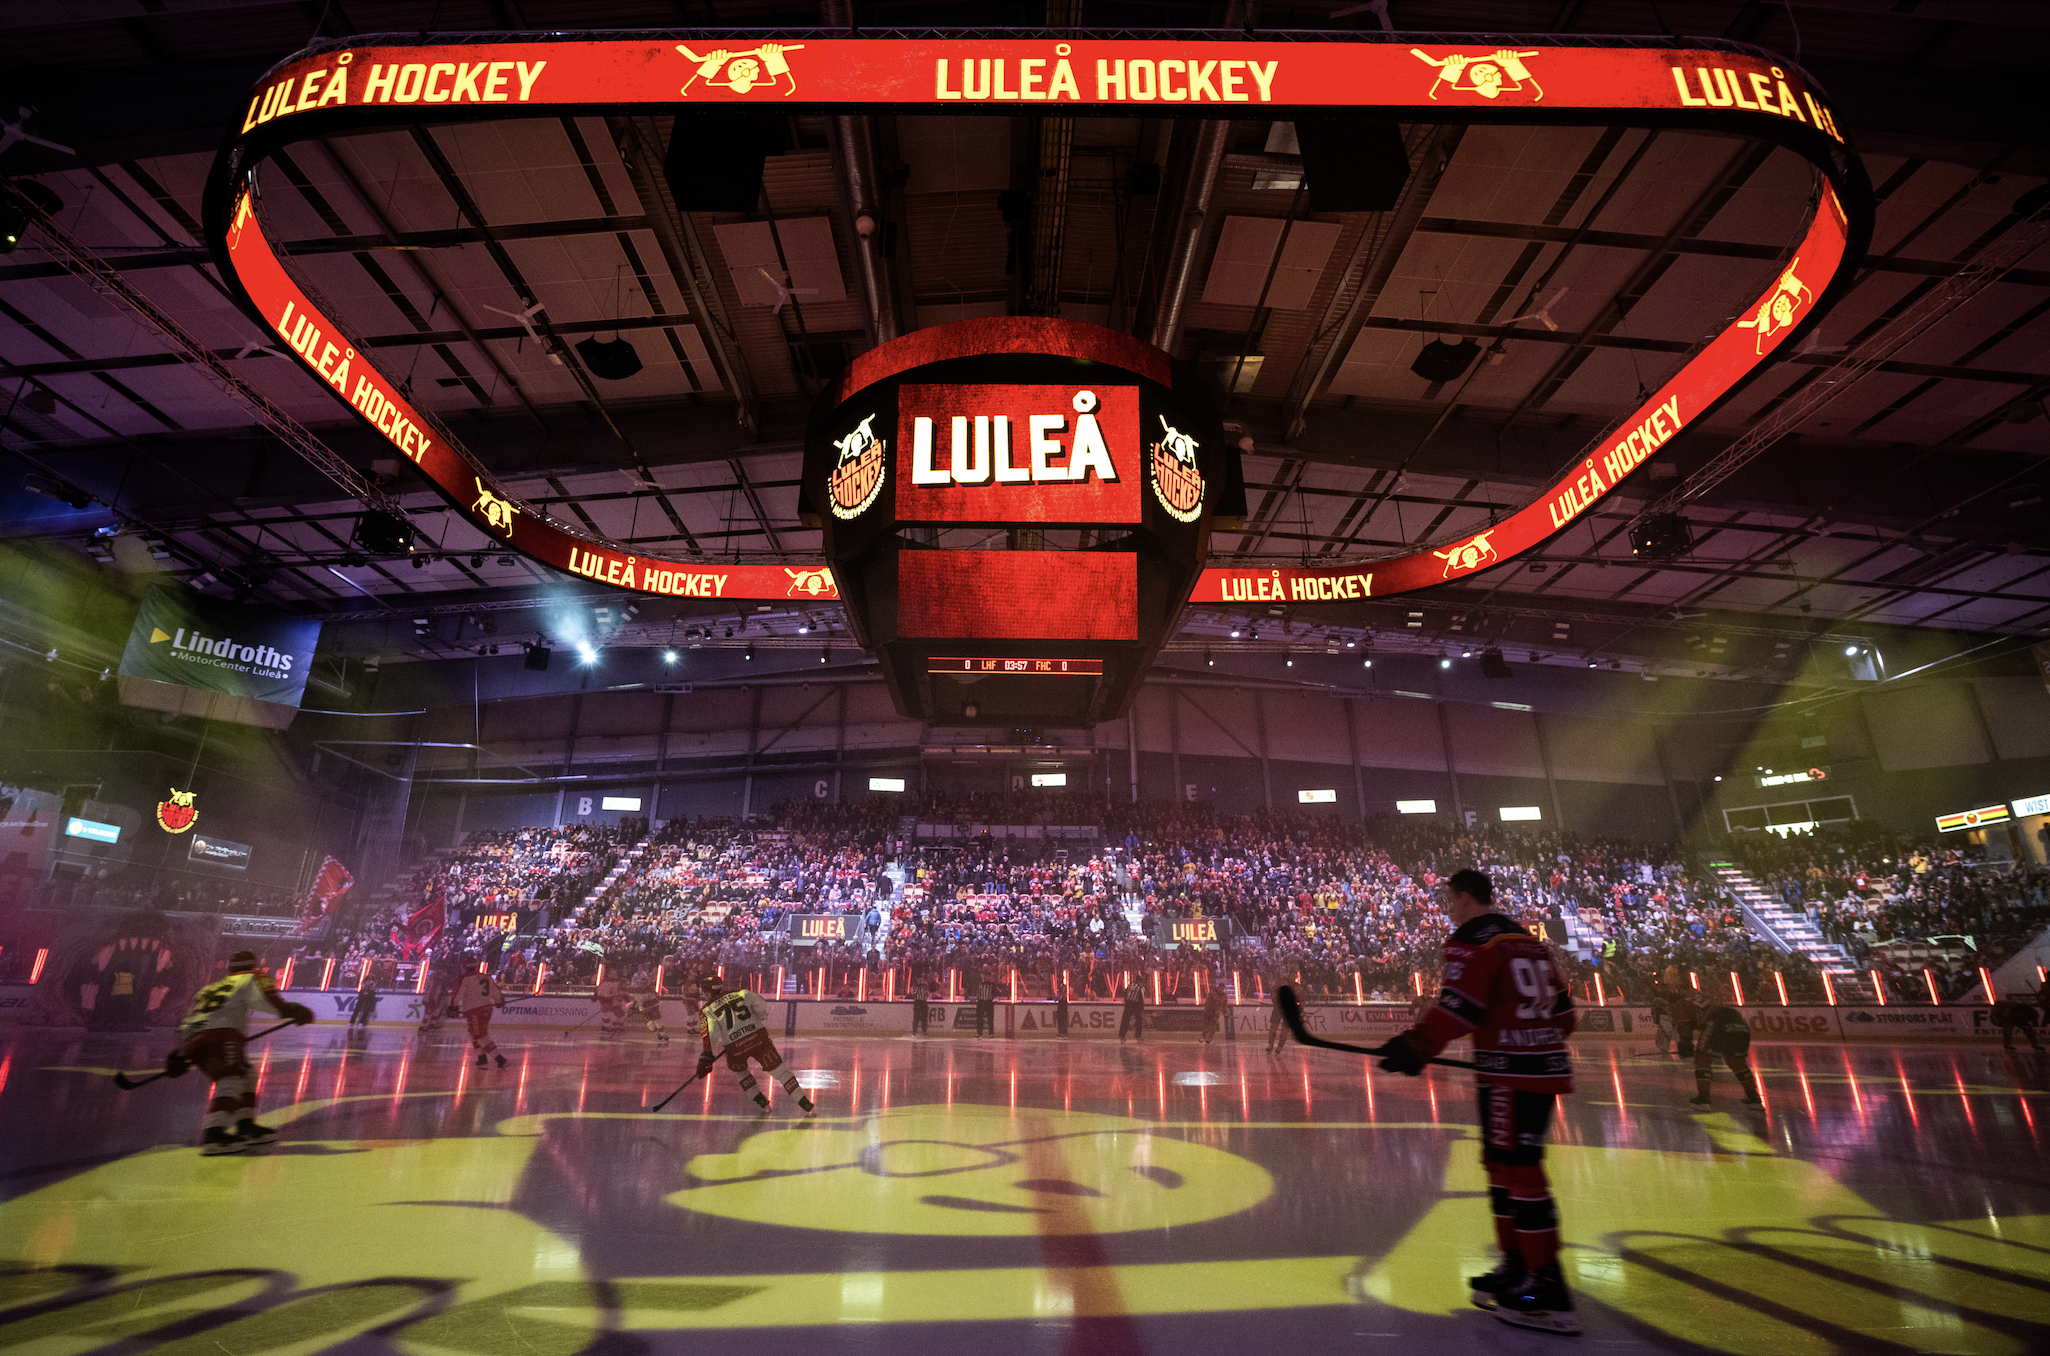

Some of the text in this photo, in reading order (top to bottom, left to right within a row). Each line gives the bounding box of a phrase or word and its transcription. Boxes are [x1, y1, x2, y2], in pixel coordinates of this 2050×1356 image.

[936, 43, 1278, 102] LULEÅ HOCKEY
[241, 52, 547, 134] LULEÅ HOCKEY
[1671, 66, 1807, 122] LULEÅ
[277, 300, 432, 464] LULEÅ HOCKEY
[911, 390, 1116, 485] LULEÅ
[1547, 393, 1685, 530] LULEÅ HOCKEY
[832, 455, 882, 507] HOCKEY
[1153, 459, 1201, 510] HOCKEY
[568, 547, 728, 597] LULEÅ HOCKEY
[1220, 569, 1373, 602] LULEÅ HOCKEY
[172, 627, 294, 671] Lindroths
[177, 651, 282, 679] MotorCenter Luleå
[964, 659, 1068, 671] 0 LHF 03:57 FHC 0
[577, 797, 593, 815] B
[814, 780, 828, 798] C
[1186, 784, 1197, 801] E
[1464, 811, 1478, 830] F
[802, 916, 845, 937] LULEÅ
[1172, 920, 1218, 941] LULEÅ
[479, 978, 490, 997] 3
[713, 996, 752, 1031] 75
[1340, 1010, 1363, 1023] ICA
